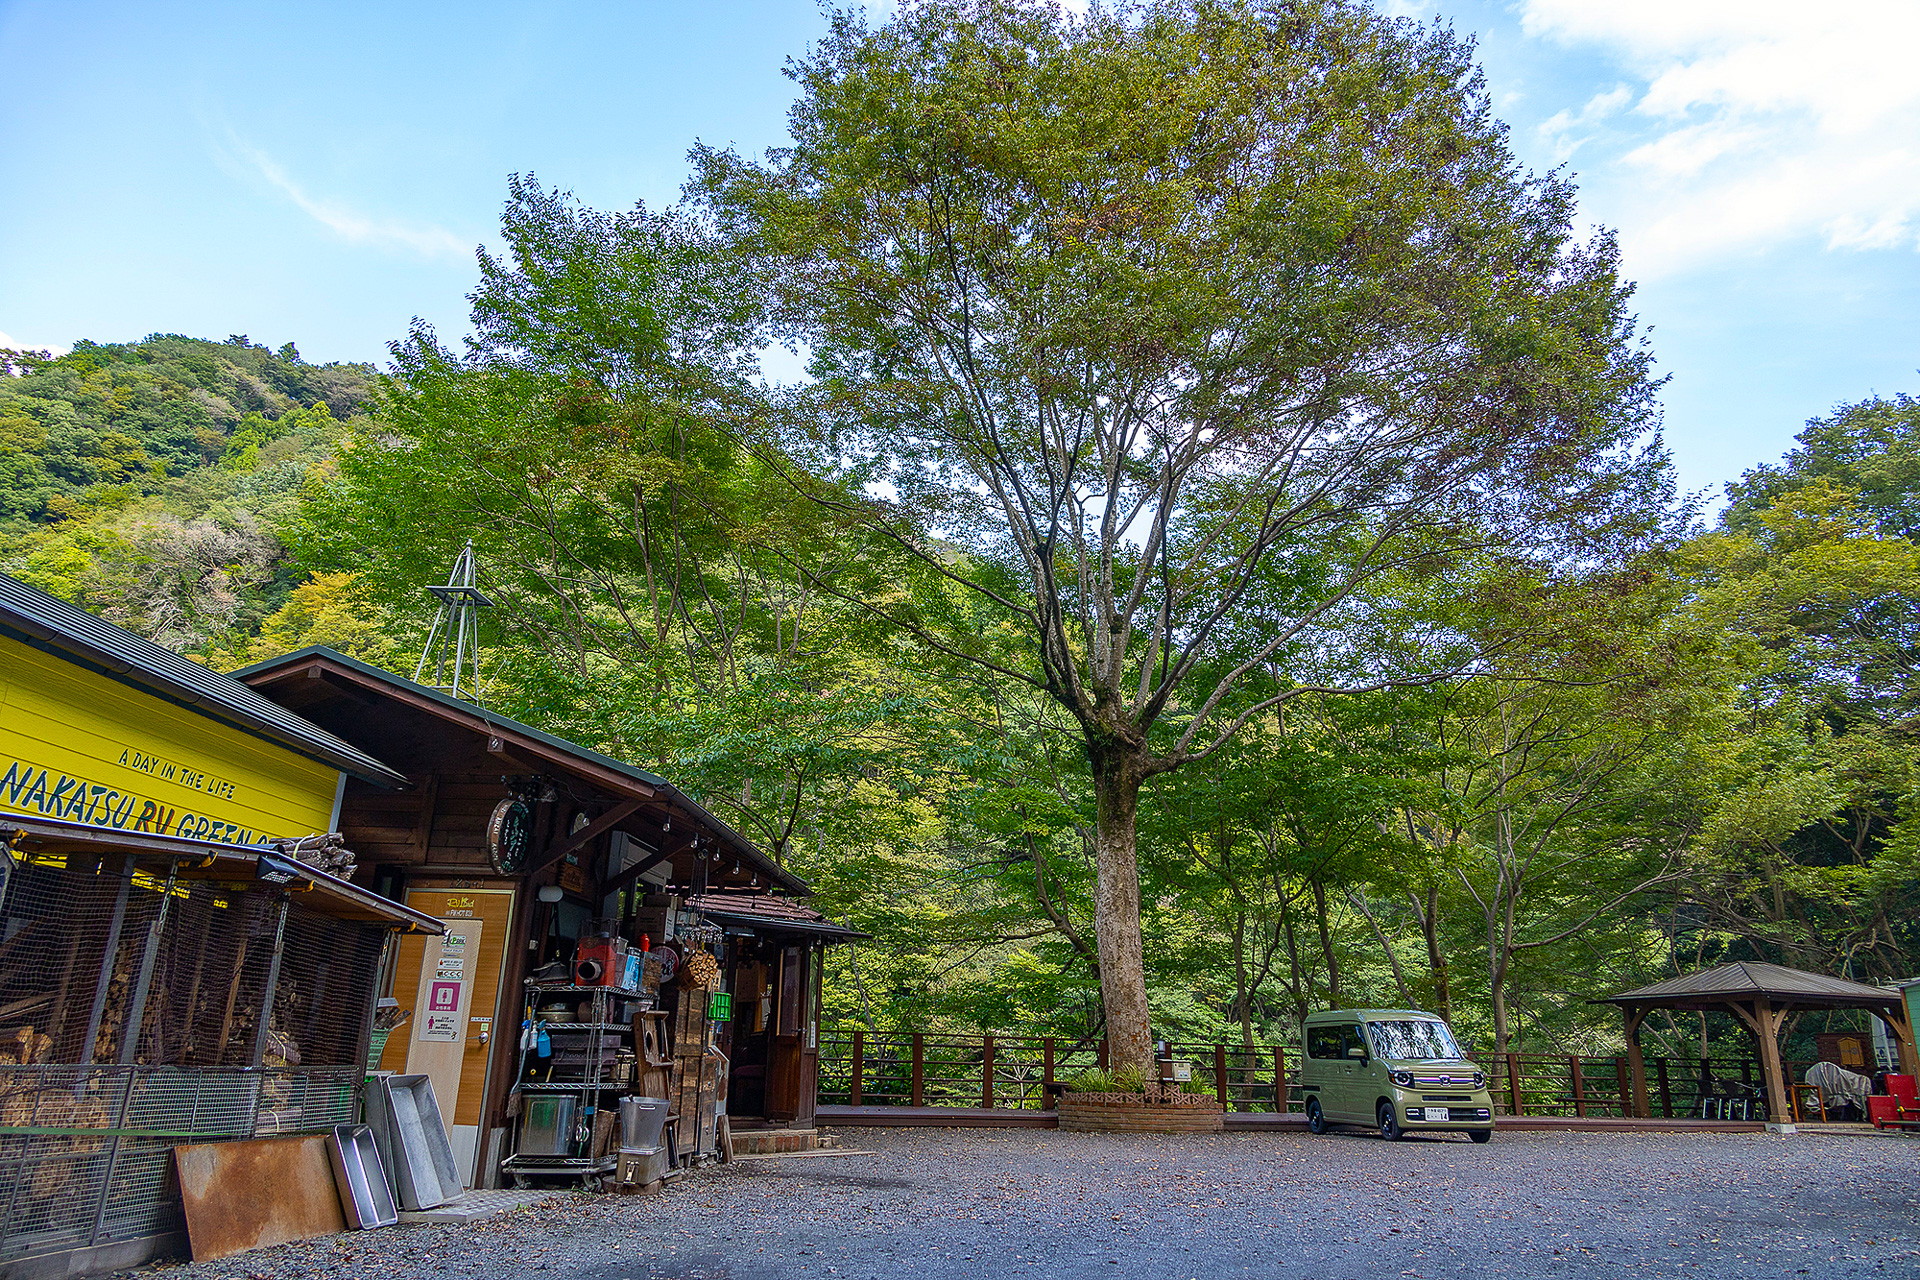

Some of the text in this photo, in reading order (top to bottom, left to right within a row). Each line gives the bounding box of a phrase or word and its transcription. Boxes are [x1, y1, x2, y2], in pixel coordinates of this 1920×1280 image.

[118, 748, 237, 801] A DAY IN THE LIFE
[133, 800, 176, 836] RV
[175, 813, 253, 845] GREEN
